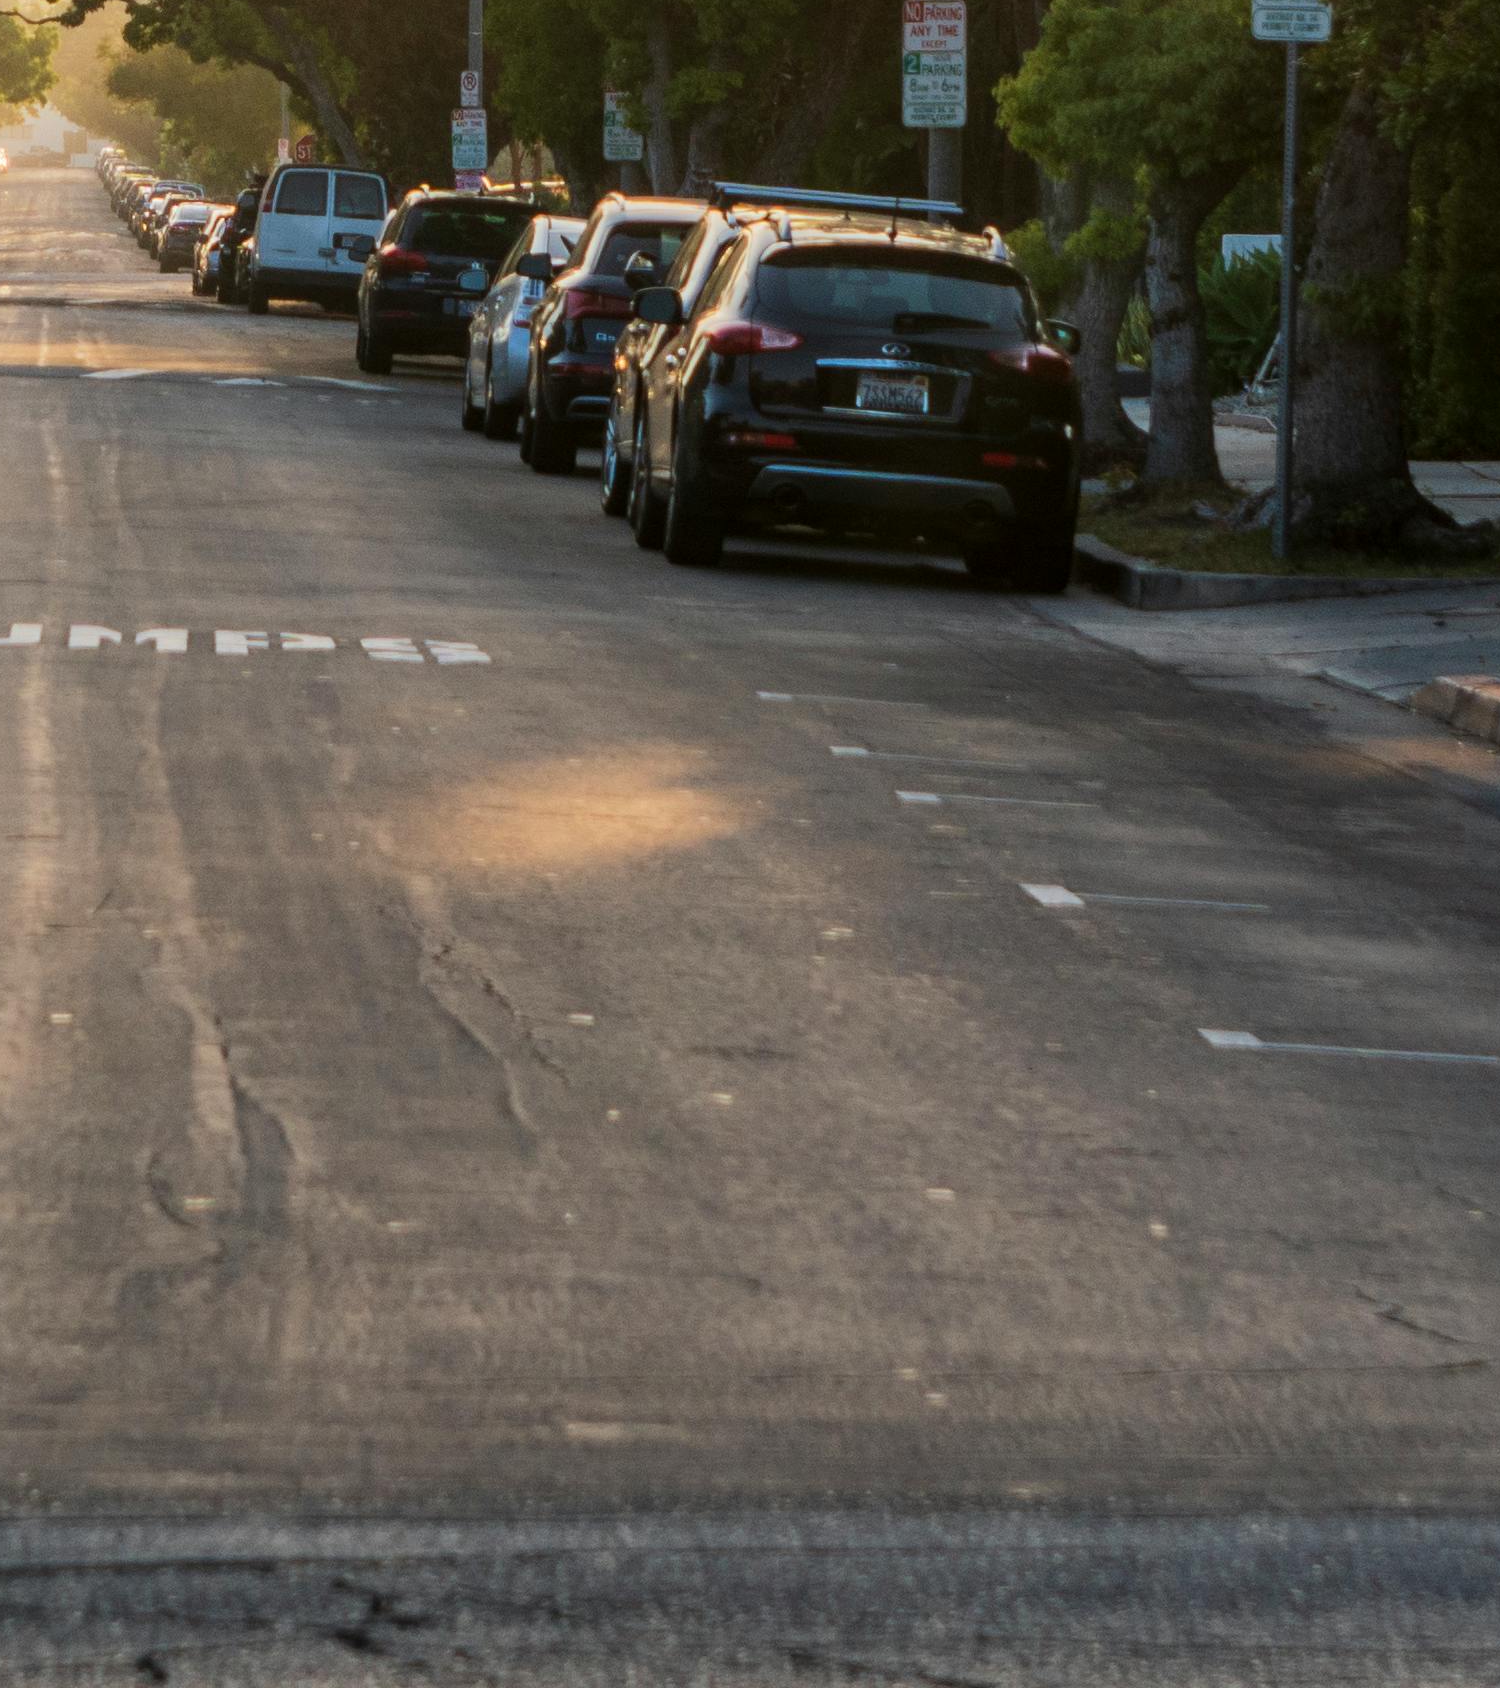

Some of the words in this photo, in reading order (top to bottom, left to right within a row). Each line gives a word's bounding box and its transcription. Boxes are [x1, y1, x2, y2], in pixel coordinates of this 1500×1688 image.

[906, 2, 922, 21] NO
[925, 6, 962, 21] PARKING
[910, 24, 931, 37] ANY
[938, 24, 959, 37] TIME
